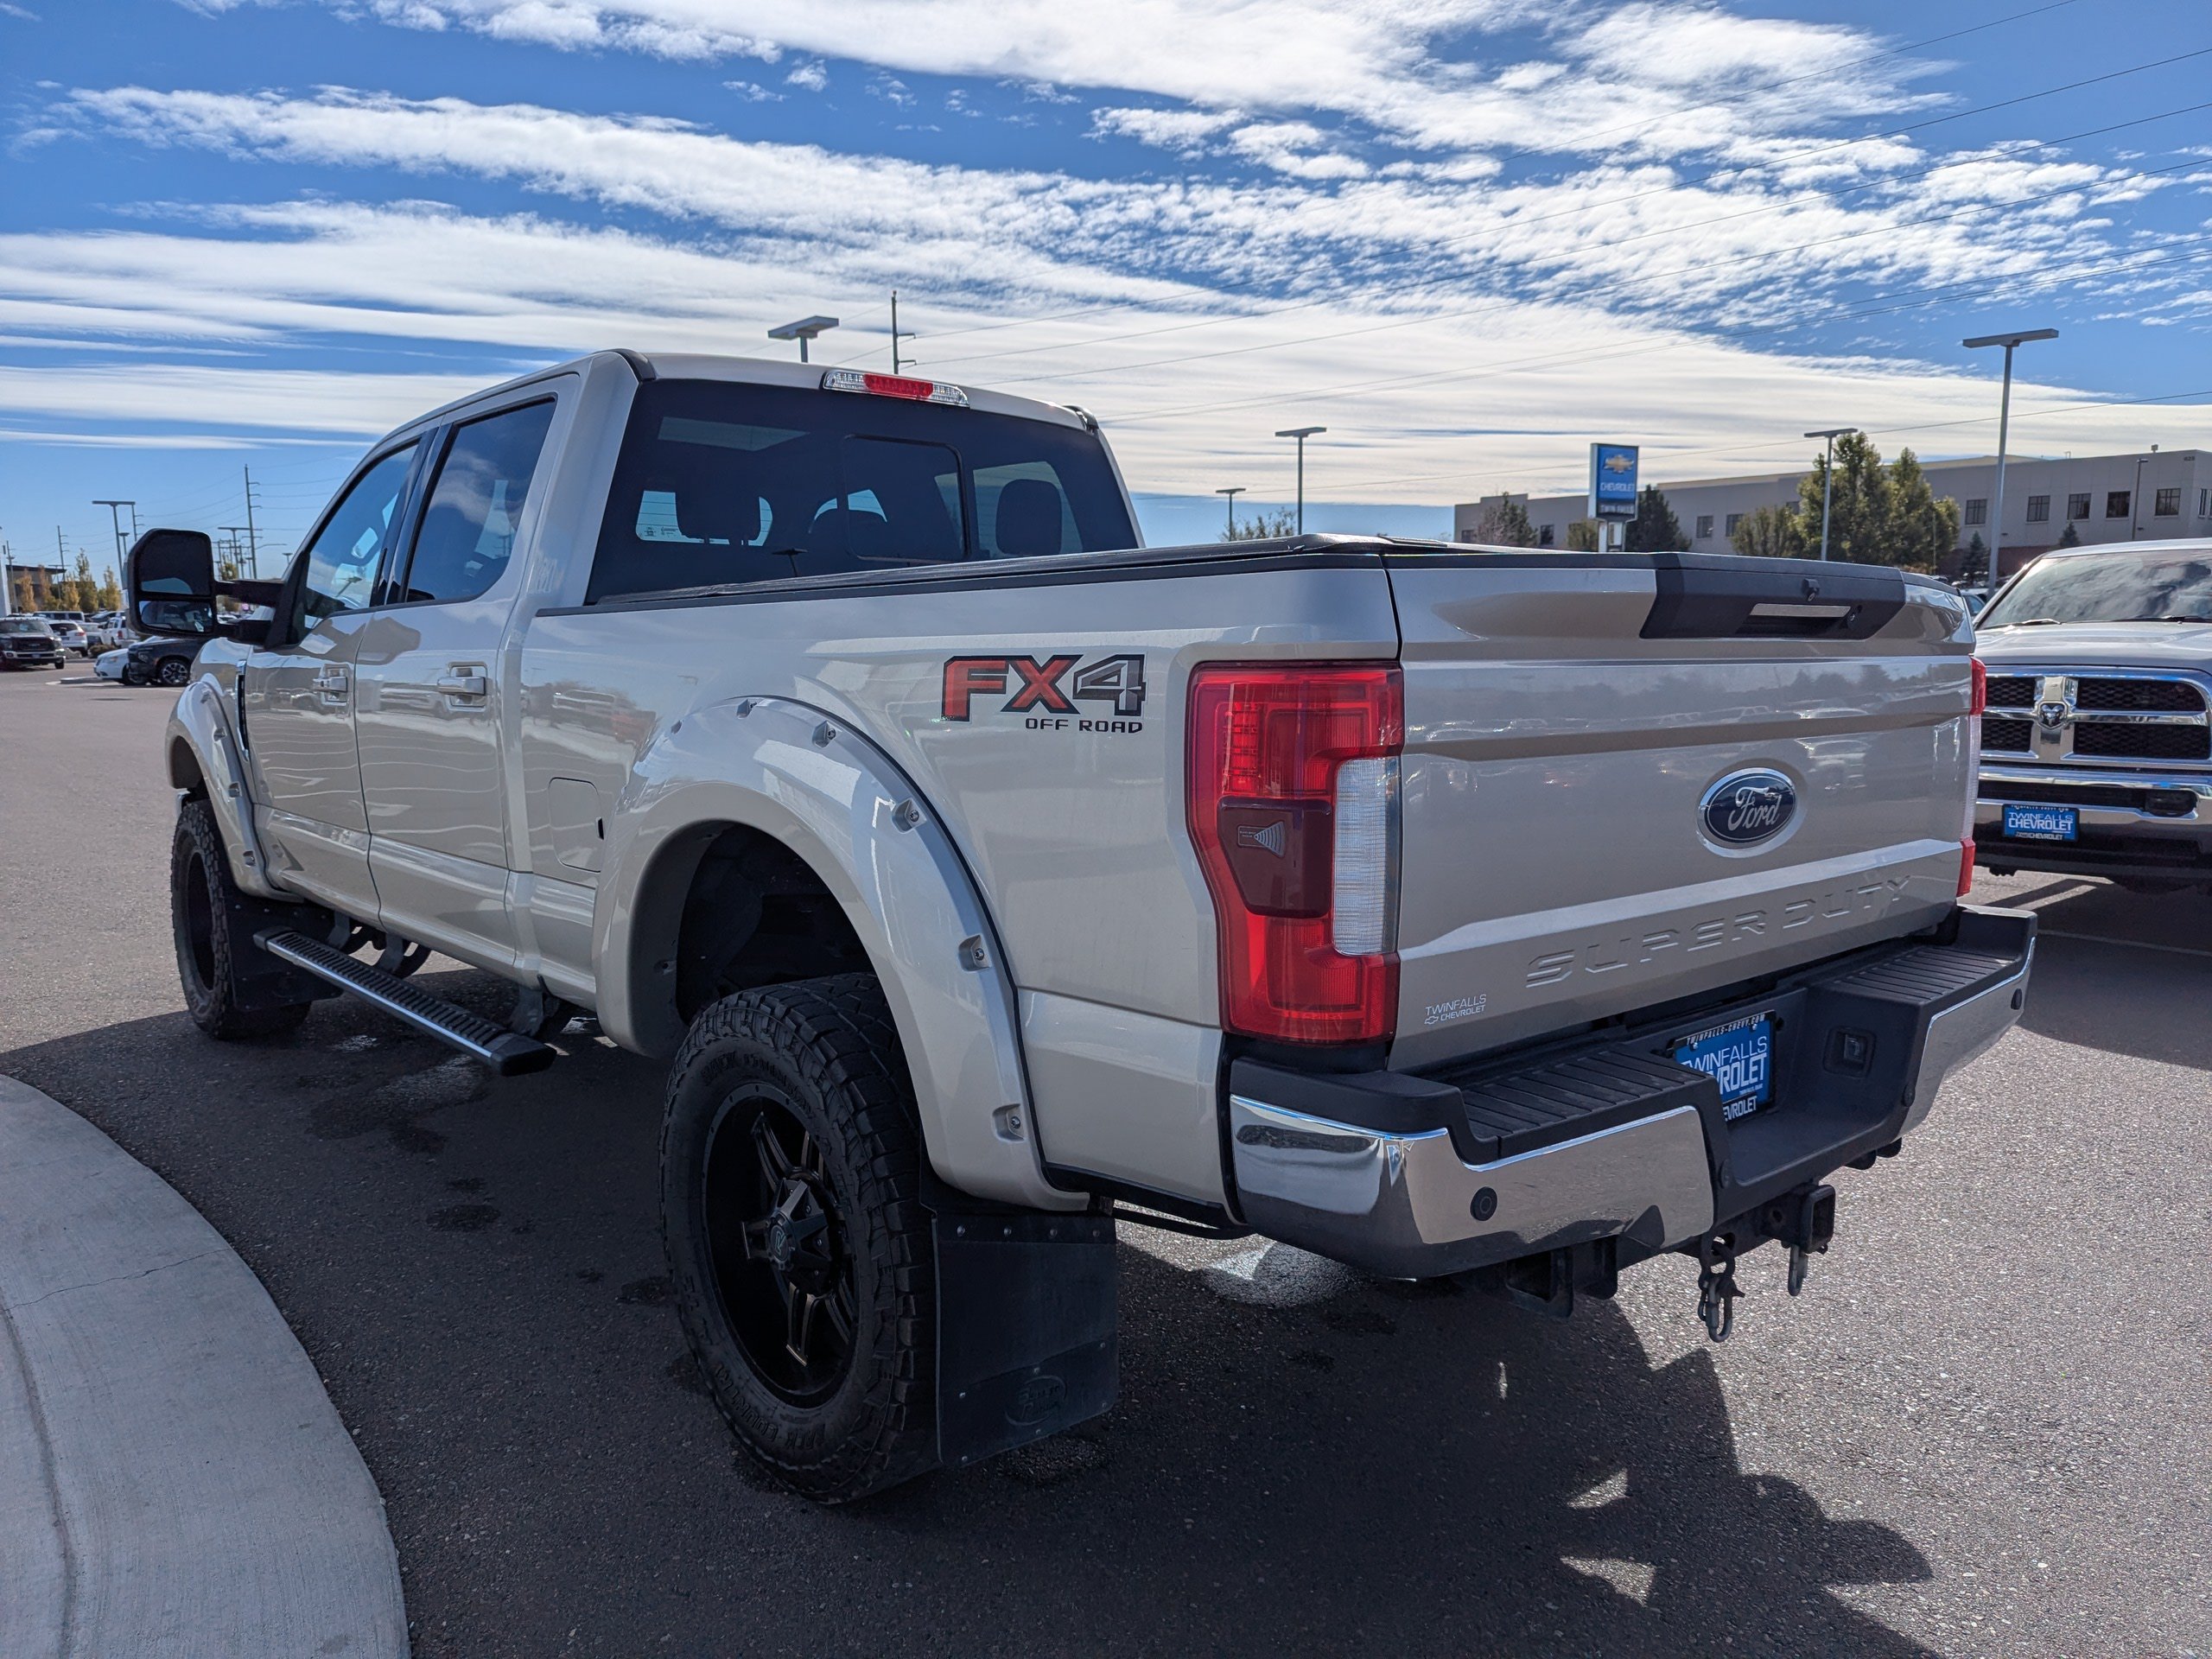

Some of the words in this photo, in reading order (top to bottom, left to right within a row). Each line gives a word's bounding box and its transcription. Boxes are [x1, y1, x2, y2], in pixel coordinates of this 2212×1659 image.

[942, 654, 1147, 721] FX4
[1025, 718, 1069, 730] OFF
[1079, 720, 1143, 734] ROAD
[1728, 786, 1782, 831] Ford
[2008, 812, 2074, 822] TWINFALLS
[2008, 817, 2074, 831] CHEVROLET
[1526, 911, 1767, 988] SUPER
[1783, 874, 1910, 929] DUTY
[1425, 994, 1487, 1016] TWINFALLS
[1440, 1005, 1486, 1021] CHEVROLET
